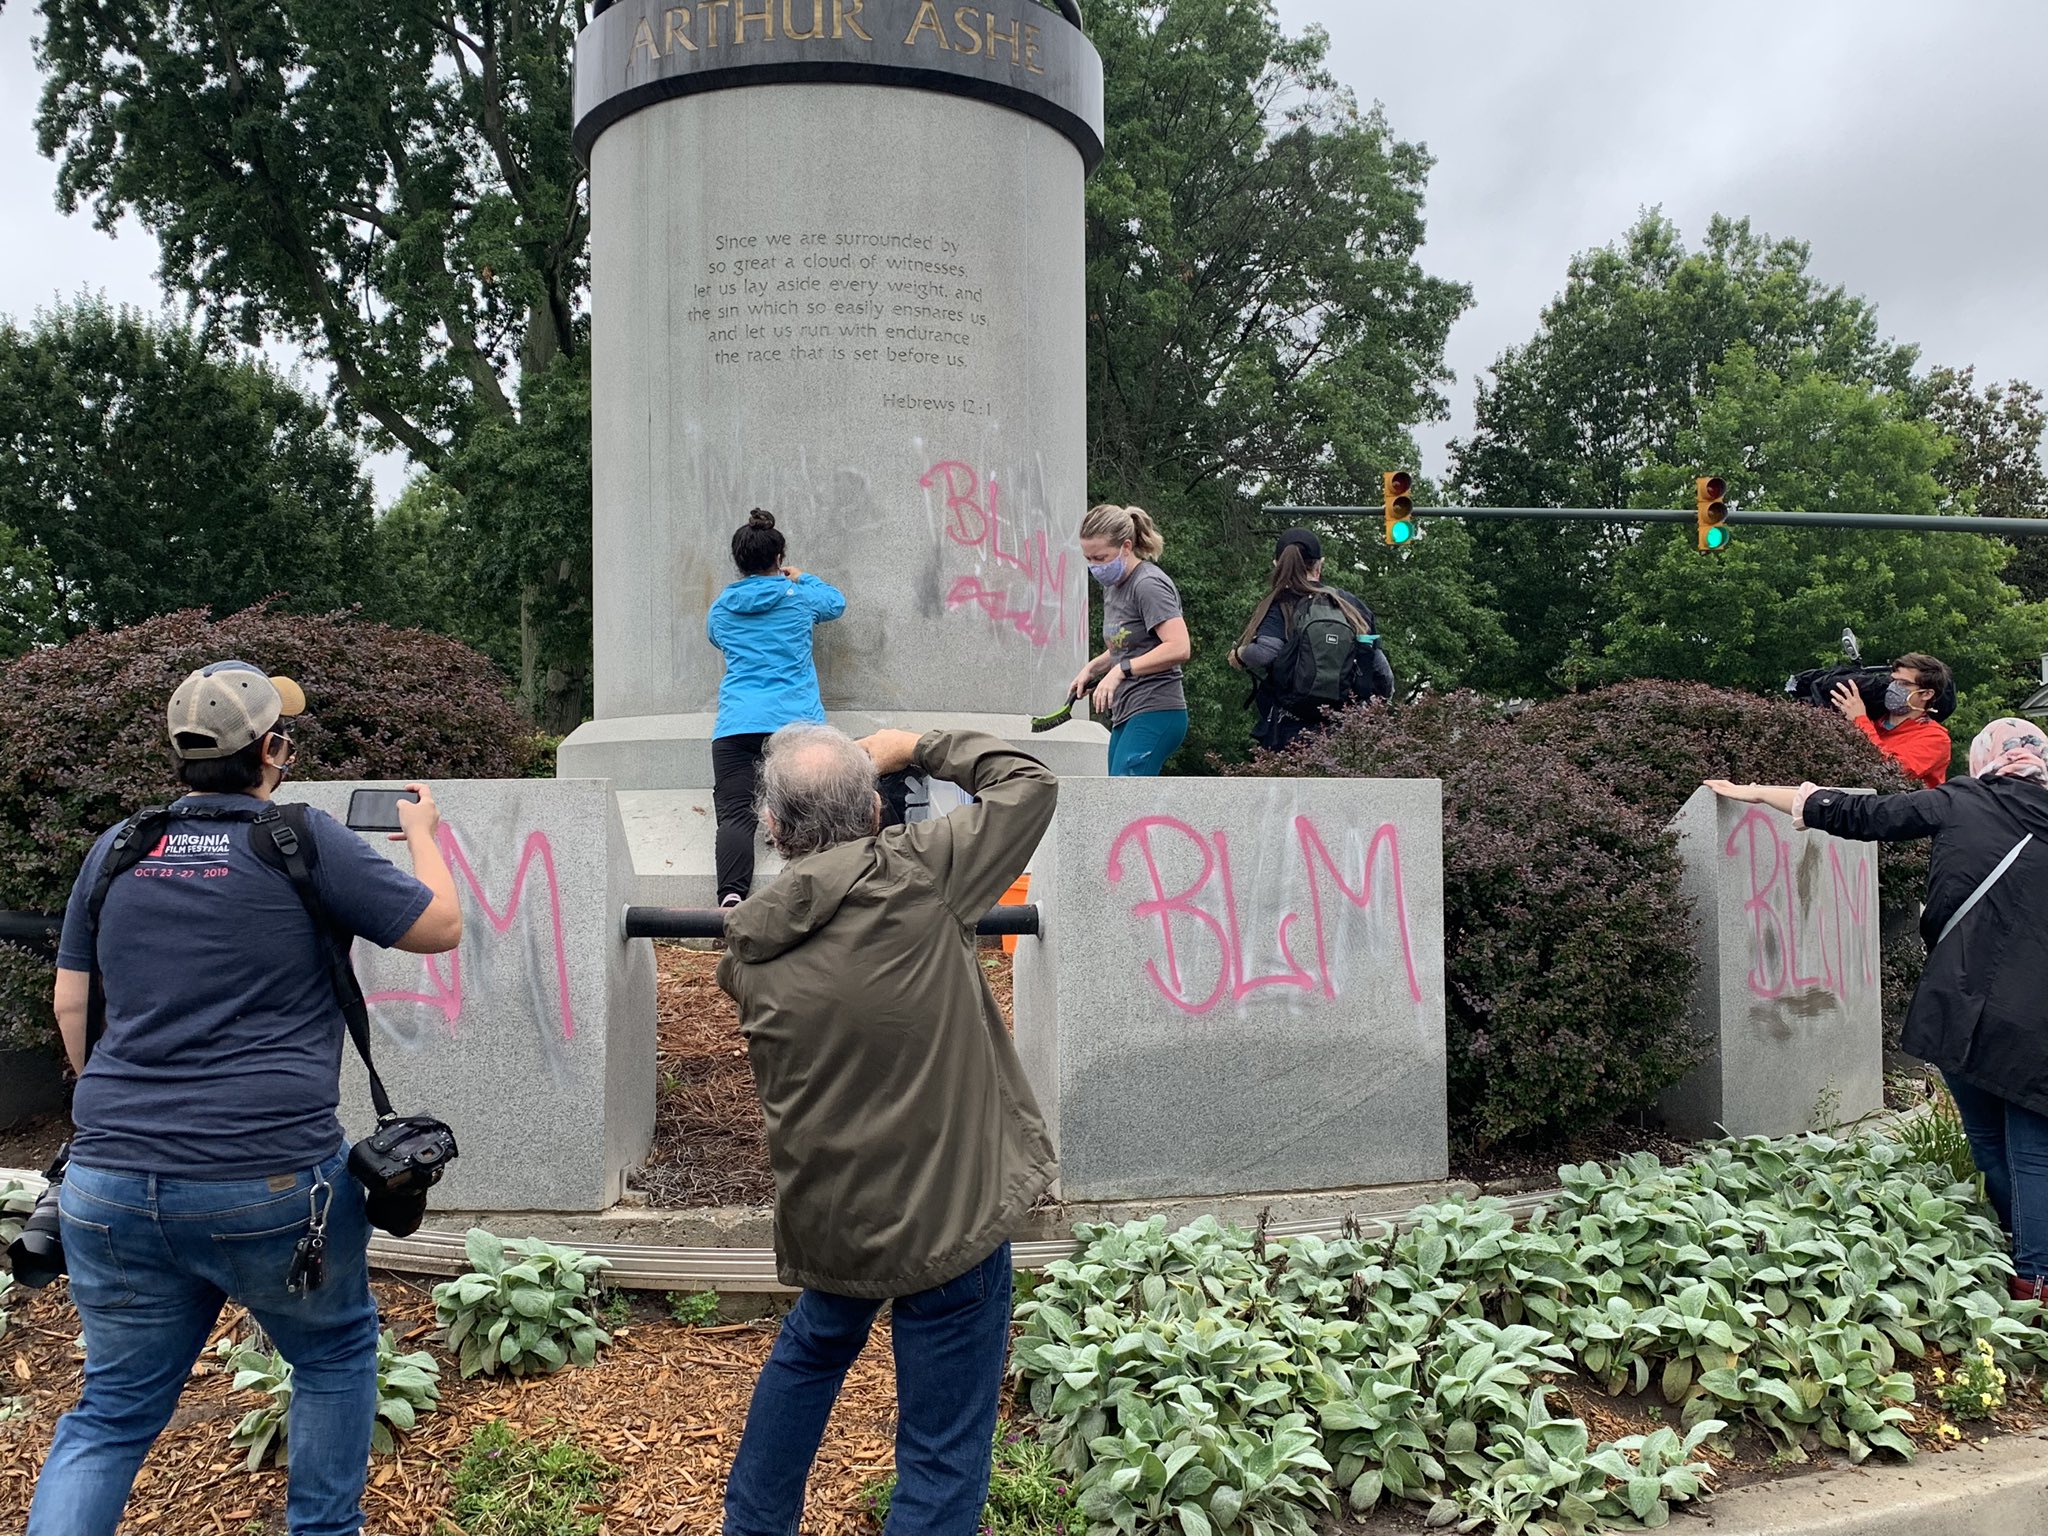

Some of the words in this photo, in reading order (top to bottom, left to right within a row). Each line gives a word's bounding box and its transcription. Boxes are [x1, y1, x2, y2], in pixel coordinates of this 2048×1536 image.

[625, 0, 873, 70] ARTHUR
[903, 0, 1046, 75] ASHE
[715, 235, 757, 251] Since
[765, 233, 791, 246] we
[800, 233, 827, 246] are
[835, 233, 932, 250] surrounded
[941, 236, 960, 258] by
[708, 261, 726, 274] so
[733, 255, 777, 277] great
[785, 257, 796, 269] a
[803, 252, 851, 269] cloud
[860, 254, 877, 270] of
[694, 283, 711, 299] let
[719, 283, 737, 296] us
[744, 278, 768, 298] lay
[776, 276, 821, 292] aside
[829, 279, 879, 297] every
[955, 288, 983, 303] and
[688, 306, 711, 321] the
[718, 304, 739, 319] sin
[747, 299, 798, 316] which
[807, 302, 827, 315] so
[834, 300, 884, 320] easily
[892, 304, 964, 322] ensnares
[708, 325, 738, 342] and
[745, 324, 765, 340] let
[773, 325, 793, 338] us
[801, 325, 831, 338] run
[838, 323, 878, 338] with
[885, 325, 970, 346] endurance
[715, 349, 739, 365] the
[747, 349, 781, 363] race
[790, 345, 824, 361] that
[832, 345, 845, 360] is
[853, 348, 878, 361] set
[887, 346, 940, 364] before
[882, 393, 955, 412] Hebrews
[919, 459, 1067, 641] BLM
[165, 845, 186, 854] FILM
[187, 845, 230, 853] FESTIVAL
[168, 833, 230, 846] VIRGINIA
[134, 868, 158, 877] OCT
[203, 867, 229, 878] 2019
[1107, 814, 1422, 1015] BLM
[1725, 807, 1873, 1000] BLM
